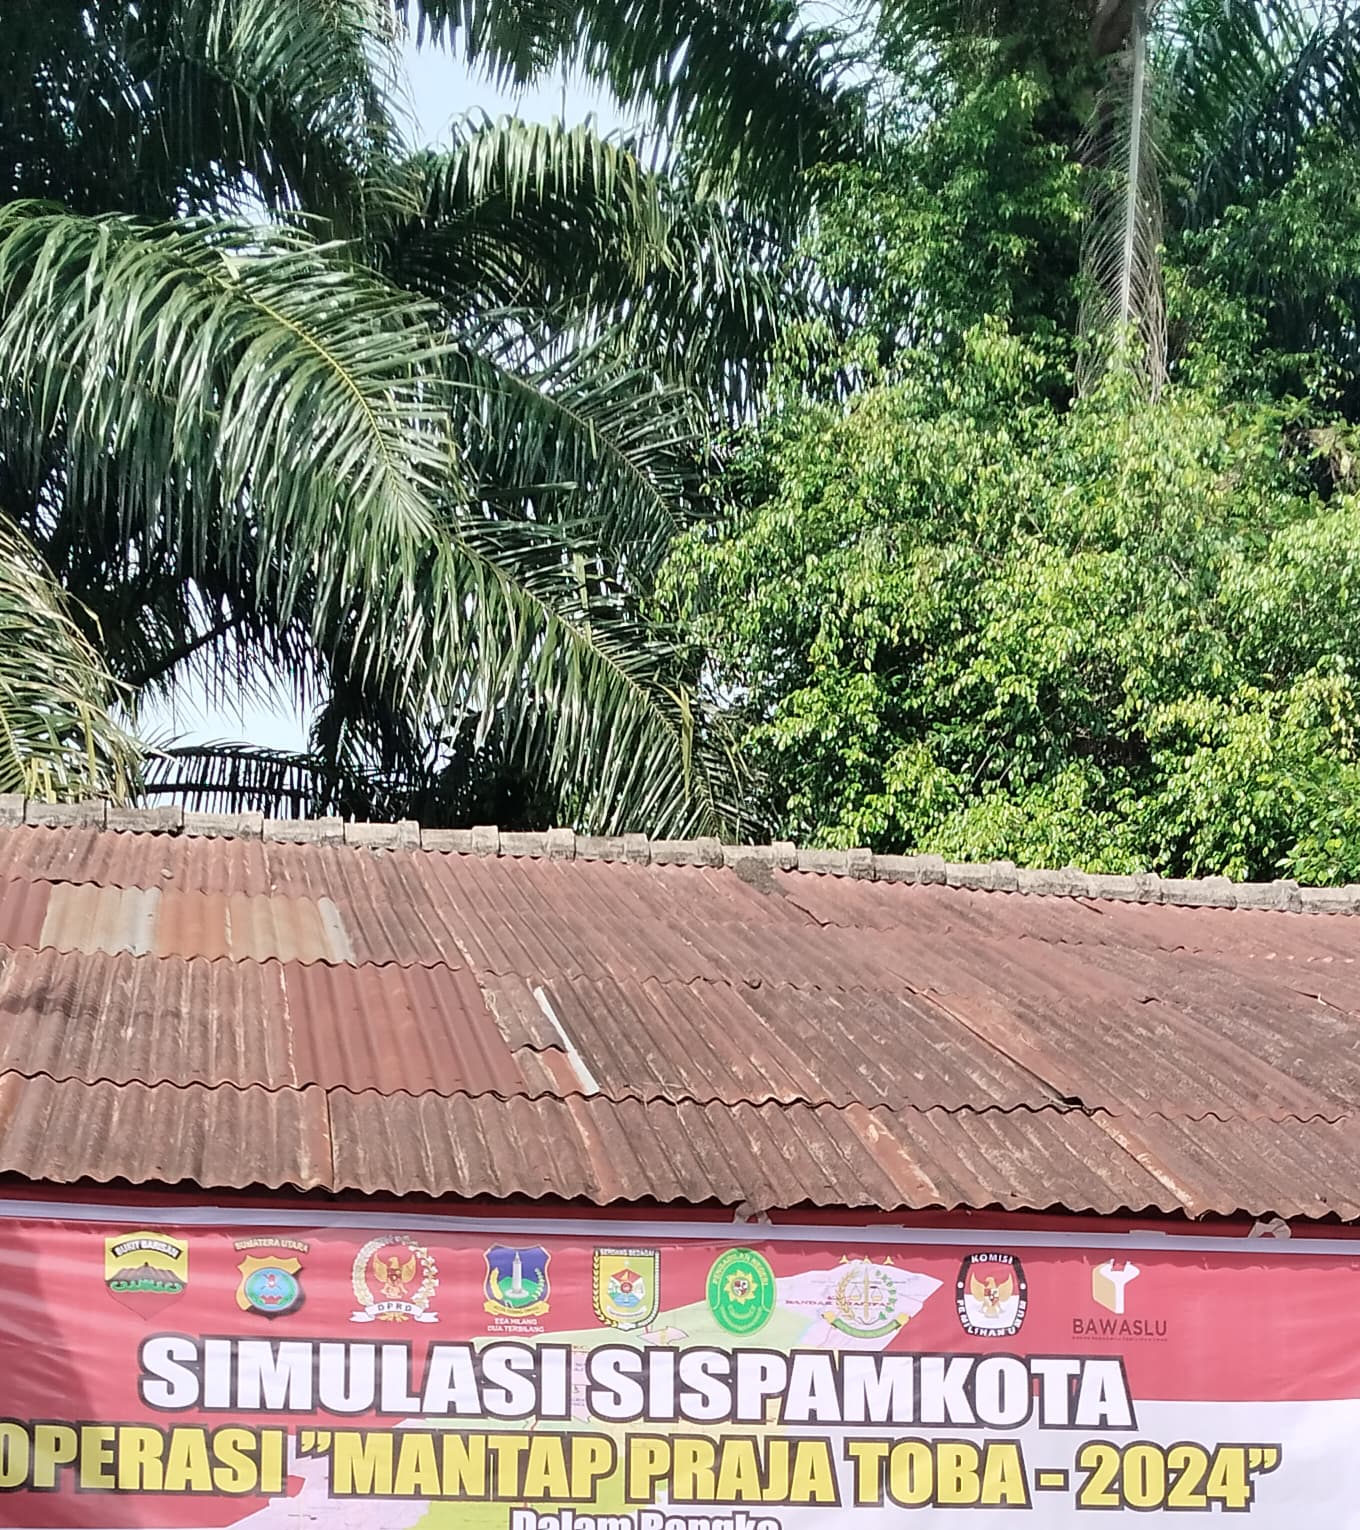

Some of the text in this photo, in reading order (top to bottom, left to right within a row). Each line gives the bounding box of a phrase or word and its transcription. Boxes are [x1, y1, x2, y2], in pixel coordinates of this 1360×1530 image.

[971, 1253, 1013, 1264] KOMISI
[378, 1302, 412, 1312] DPRD
[1072, 1318, 1167, 1336] BAWASLU
[140, 1335, 1137, 1430] SIMULASI SISPAMKOTA
[627, 1434, 840, 1509] PRAJA
[847, 1439, 1033, 1510] TOBA
